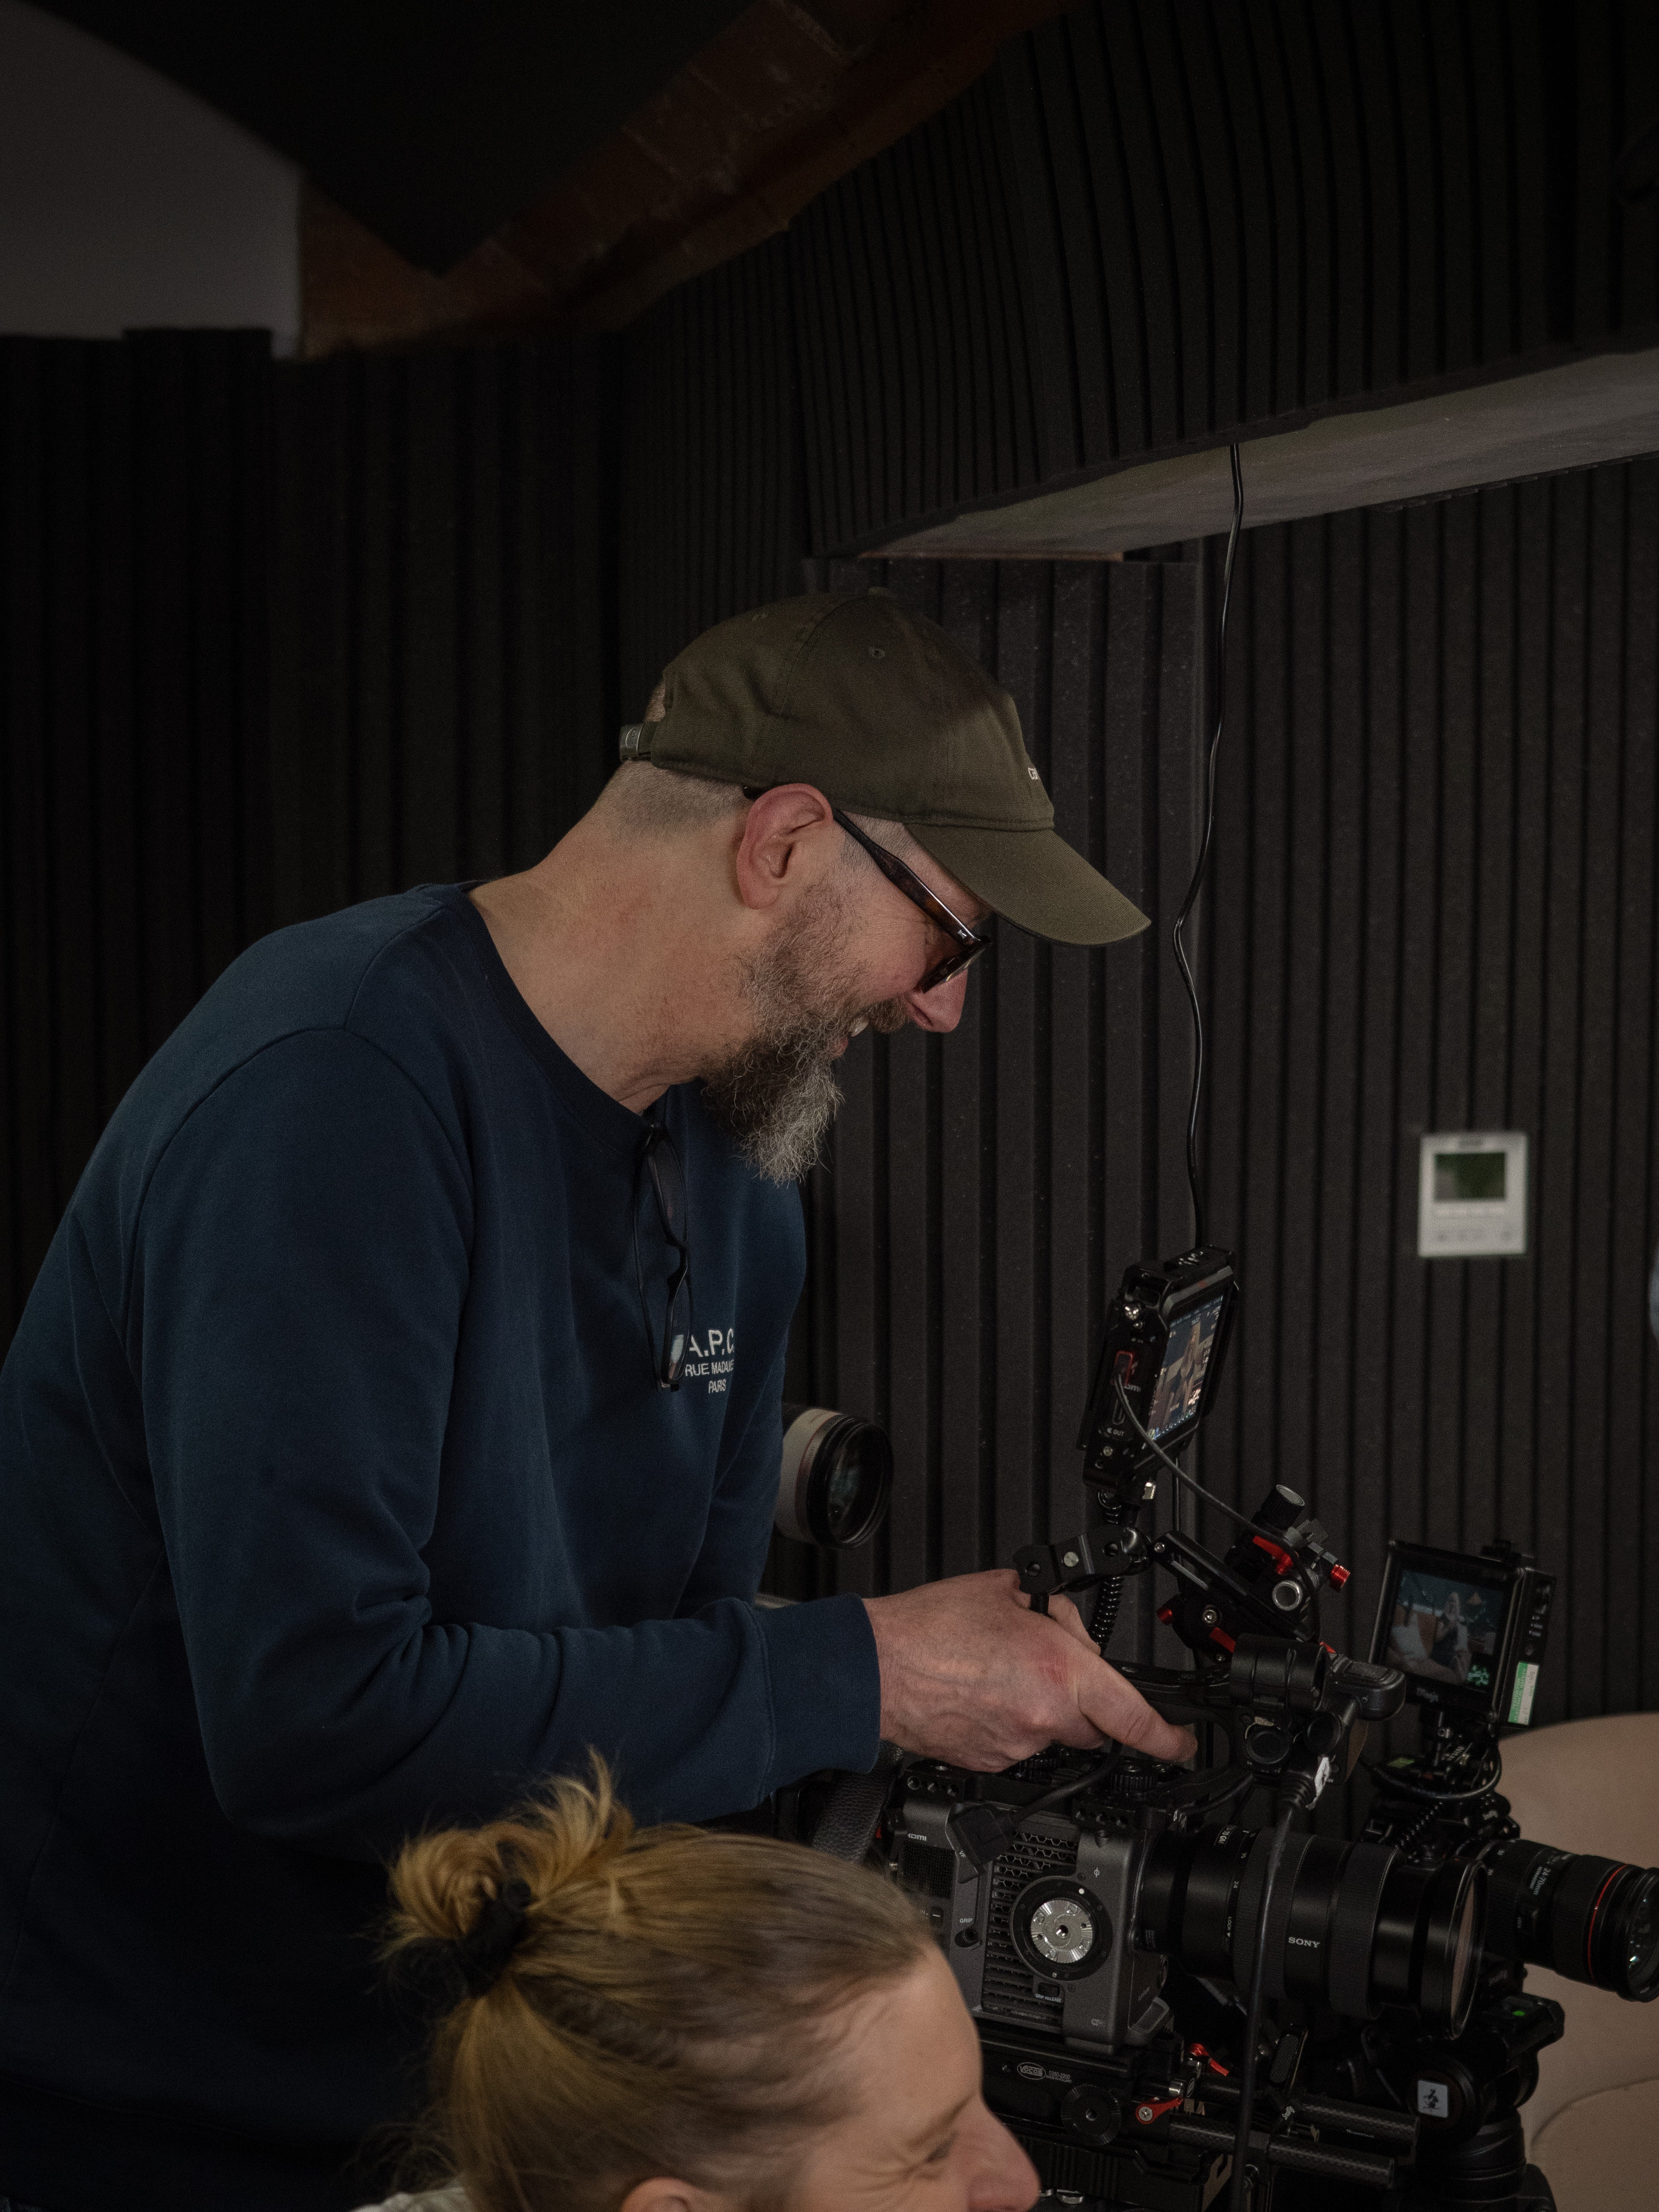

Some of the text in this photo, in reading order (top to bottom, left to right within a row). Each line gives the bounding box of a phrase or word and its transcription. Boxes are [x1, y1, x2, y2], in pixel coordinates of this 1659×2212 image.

[685, 1363, 710, 1377] RUE
[708, 1379, 726, 1394] PARIS
[959, 1850, 966, 1858] VF
[1533, 1866, 1551, 1895] 24-70mm
[1289, 1937, 1320, 1948] SONY
